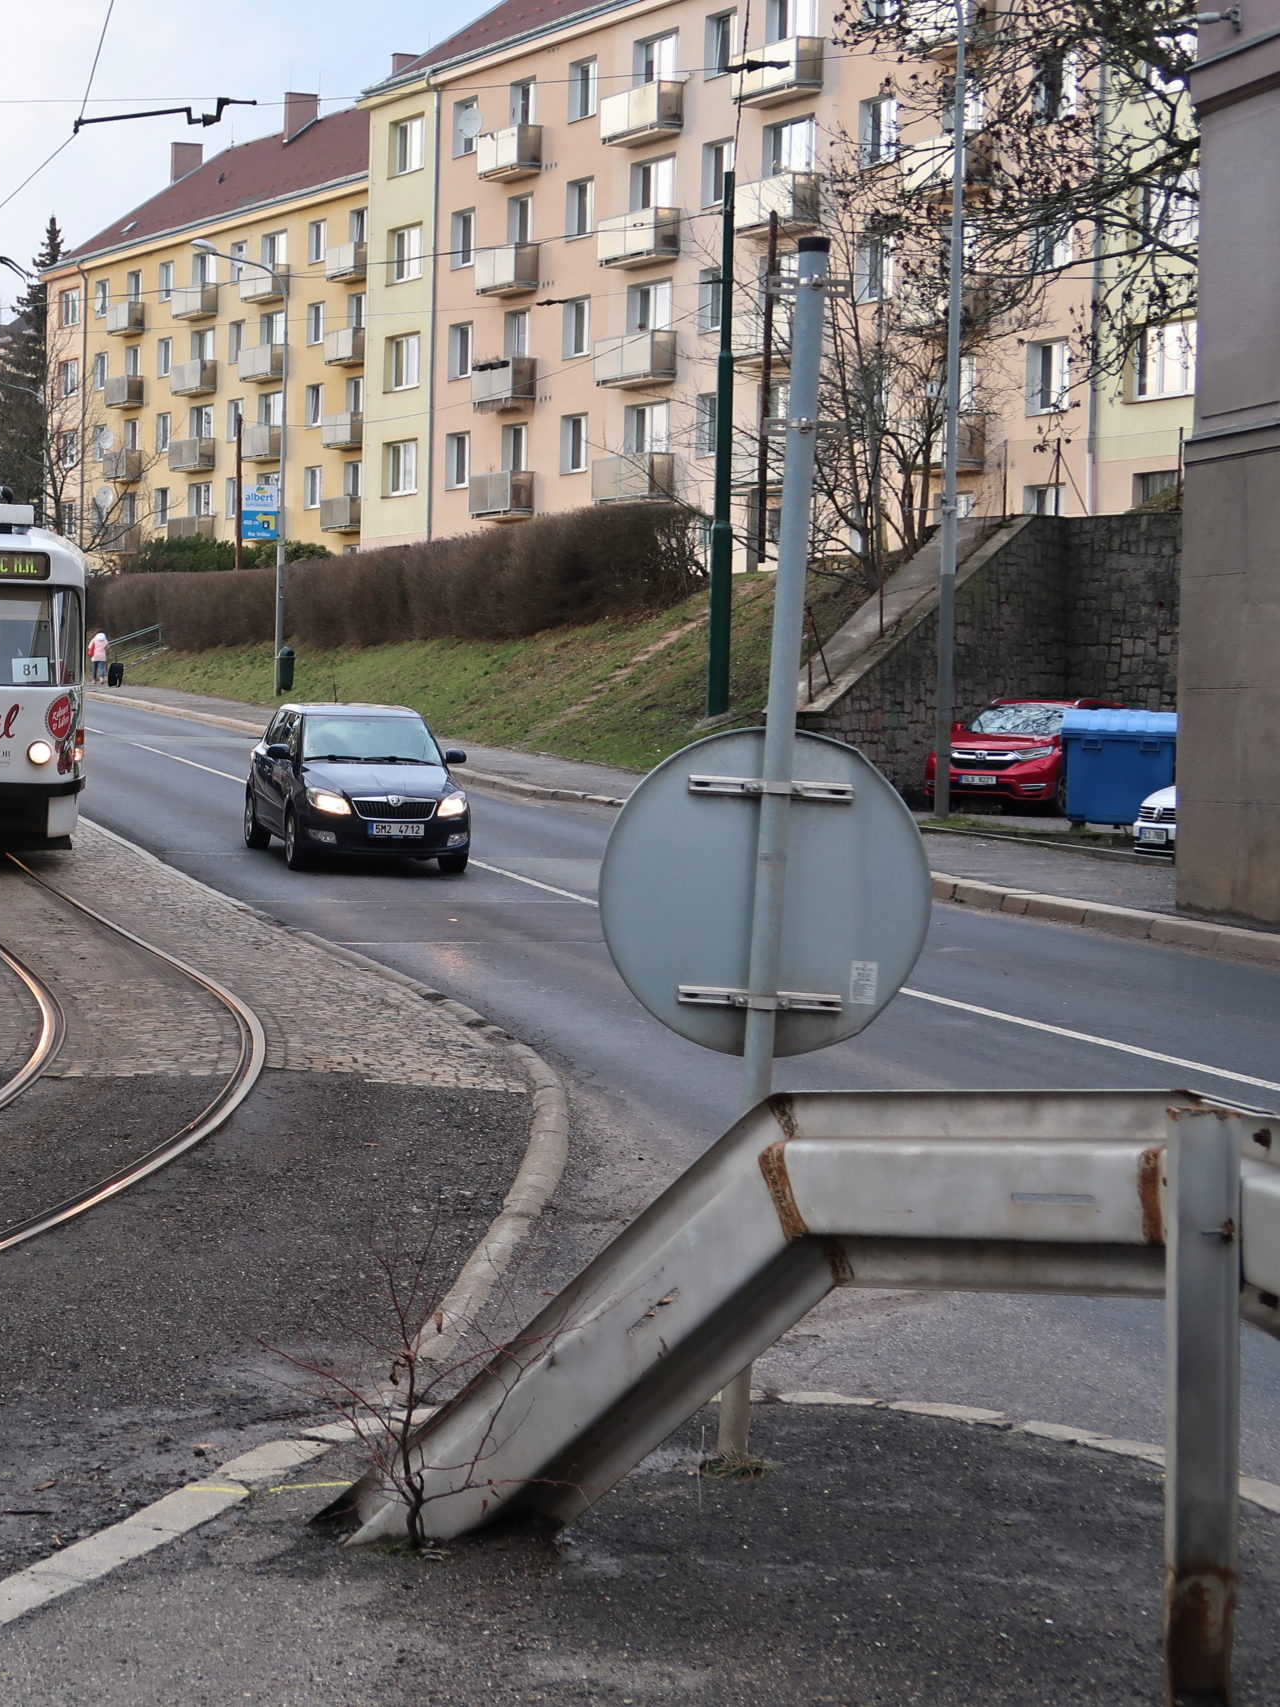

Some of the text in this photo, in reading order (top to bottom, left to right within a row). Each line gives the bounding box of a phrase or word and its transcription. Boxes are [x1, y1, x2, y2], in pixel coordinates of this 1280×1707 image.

[245, 493, 273, 501] albert
[23, 664, 38, 676] 81
[375, 824, 420, 834] 5M2 4712
